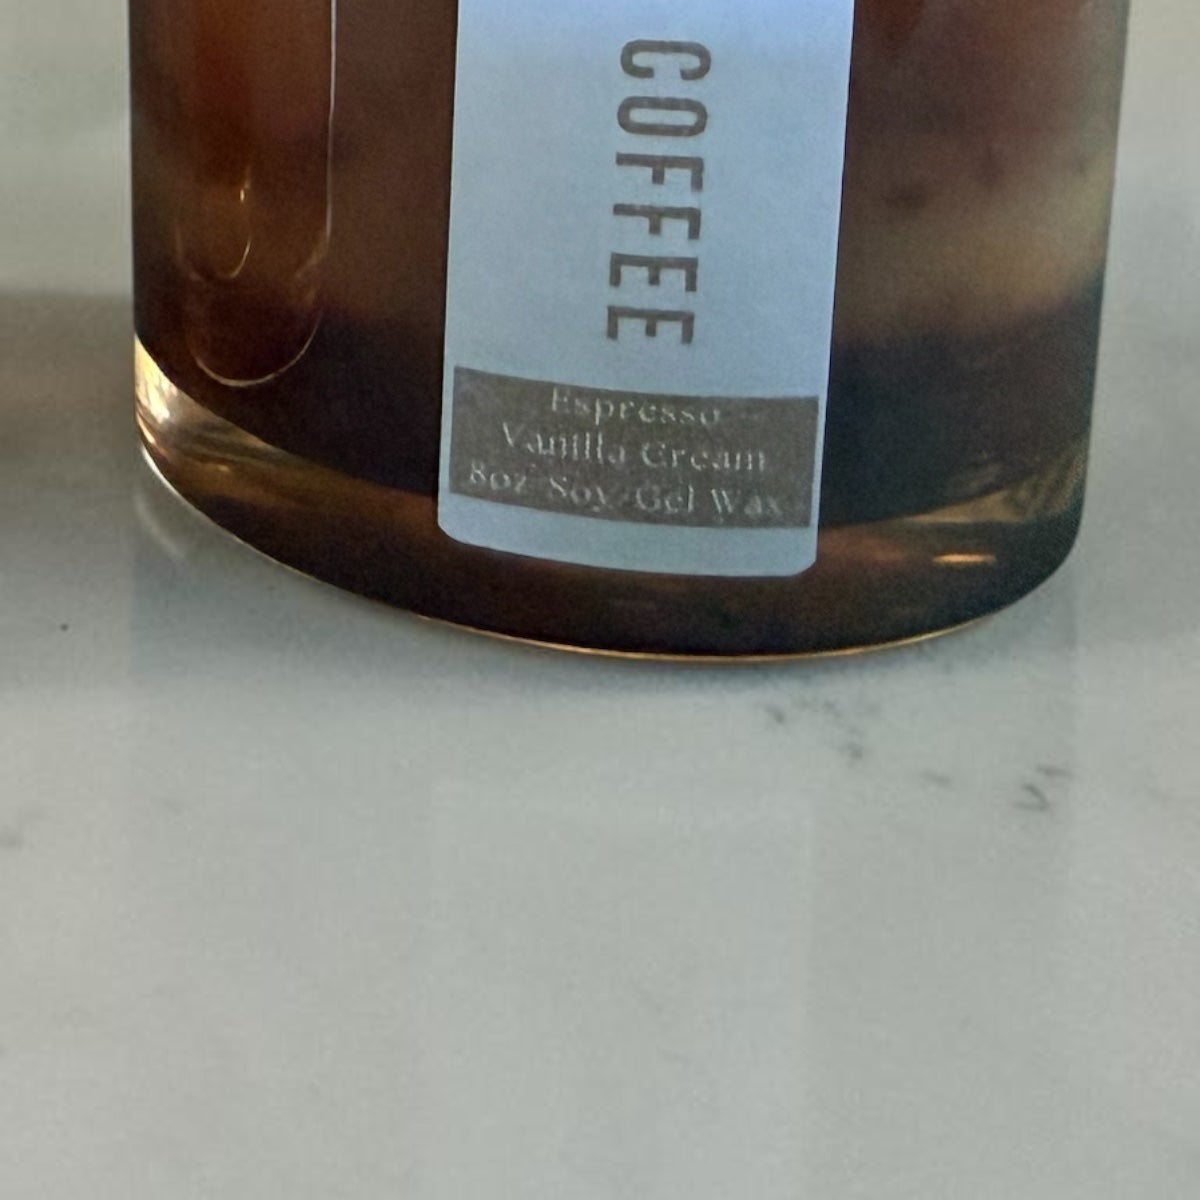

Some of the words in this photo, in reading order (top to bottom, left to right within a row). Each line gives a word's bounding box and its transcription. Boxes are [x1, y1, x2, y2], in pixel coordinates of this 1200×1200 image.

[606, 39, 712, 344] COFFEE
[550, 388, 721, 427] Espresso
[501, 421, 626, 465] Vanilla
[640, 442, 767, 472] Cream
[467, 461, 527, 492] 8oz
[710, 488, 782, 516] Wax
